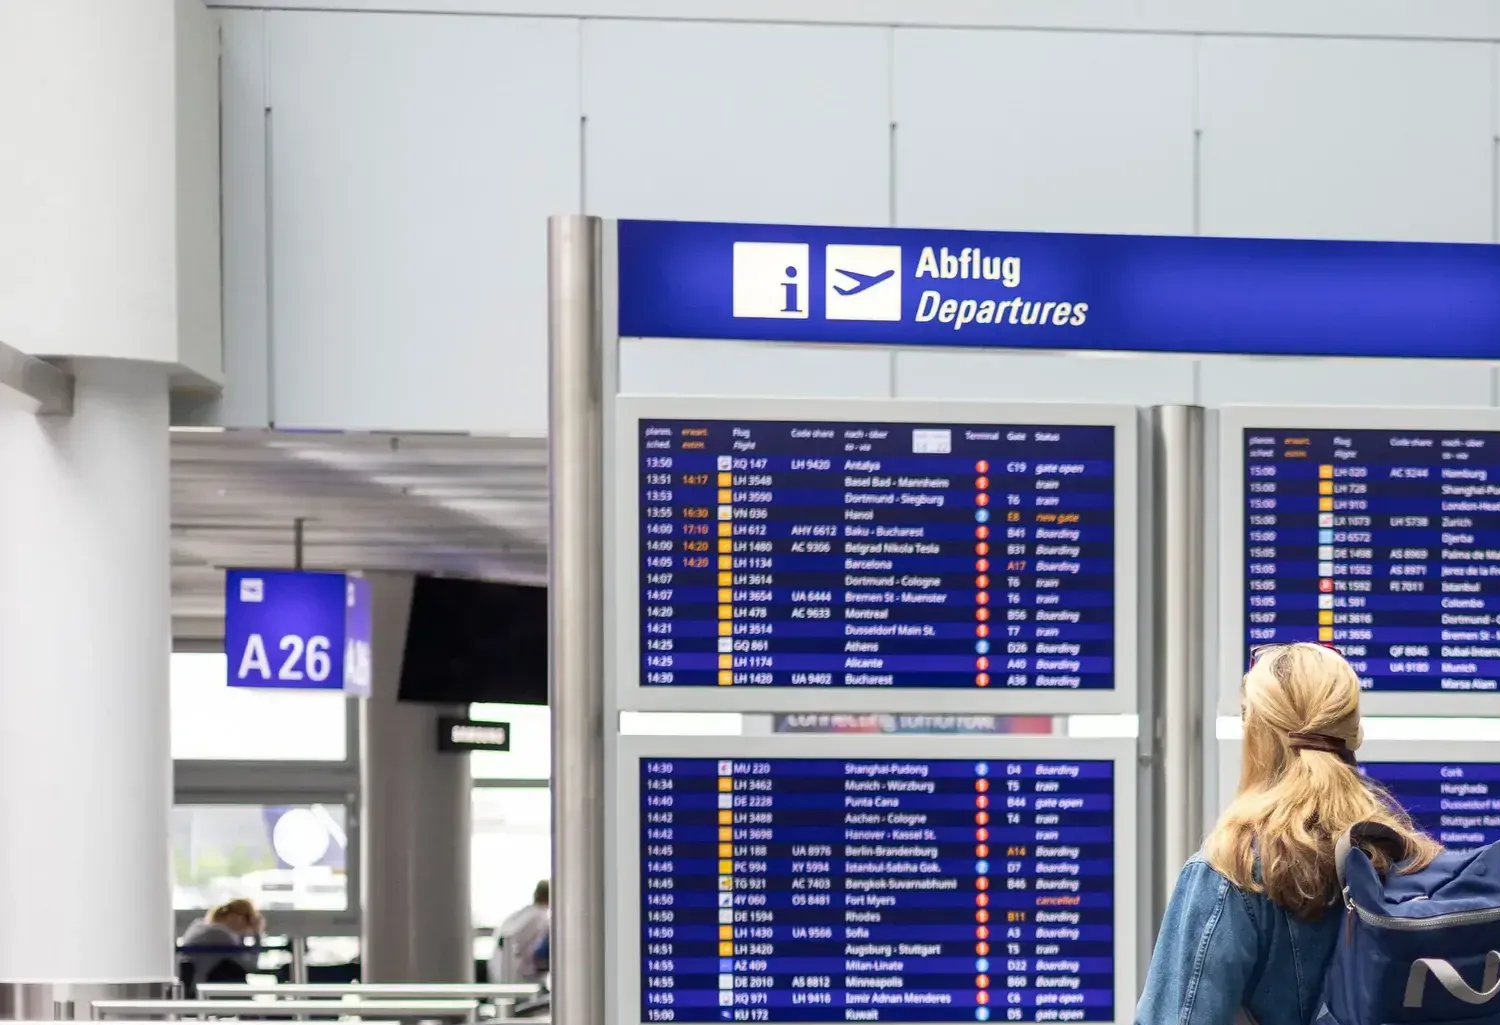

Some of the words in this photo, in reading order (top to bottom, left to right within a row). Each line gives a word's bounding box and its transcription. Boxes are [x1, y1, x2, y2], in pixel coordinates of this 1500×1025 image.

[915, 247, 1020, 287] Abflug
[915, 290, 1088, 330] Departures
[647, 457, 672, 468] 13:50
[750, 458, 767, 468] 147
[791, 460, 805, 469] LH
[806, 459, 830, 470] 9420
[844, 460, 880, 472] Antalya
[1007, 462, 1026, 472] C19
[1035, 464, 1057, 475] gate
[1058, 464, 1084, 475] open
[647, 474, 671, 484] 13:51
[683, 475, 708, 484] 14:17
[733, 475, 746, 485] LH
[845, 477, 870, 487] Basel
[872, 477, 891, 487] Bad
[898, 477, 949, 488] Mannheim
[1036, 480, 1059, 489] train
[647, 507, 672, 517] 13:55
[683, 508, 708, 518] 16:30
[845, 510, 873, 520] Hanoi
[1036, 514, 1056, 522] new
[1057, 514, 1079, 524] gate
[683, 557, 709, 567] 14:20
[733, 558, 747, 568] LH
[749, 558, 772, 568] 1134
[845, 559, 892, 569] Barcelona
[1007, 561, 1026, 570] A17
[1036, 561, 1080, 573] Boarding
[1442, 583, 1480, 592] Istanbul
[648, 607, 673, 617] 14:20
[734, 608, 747, 617] LH
[792, 608, 805, 618] AC
[845, 608, 888, 619] Montreal
[1036, 610, 1080, 623] Boarding
[647, 623, 671, 633] 14:21
[734, 624, 747, 634] LH
[749, 623, 772, 634] 3514
[845, 624, 897, 635] Dusseldorf
[898, 625, 921, 635] Main
[1008, 626, 1020, 636] T7
[1036, 628, 1059, 636] train
[648, 639, 673, 650] 14:25
[845, 641, 878, 652] Athens
[1036, 643, 1080, 655] Boarding
[648, 656, 673, 666] 14:25
[734, 657, 747, 667] LH
[750, 656, 772, 667] 1174
[845, 658, 883, 668] Alicante
[1036, 659, 1080, 672] Boarding
[1442, 663, 1477, 672] Munich
[648, 672, 673, 683] 14:30
[734, 674, 747, 684] LH
[792, 674, 806, 684] UA
[845, 674, 893, 685] Bucharest
[1035, 676, 1081, 689] Boarding
[648, 763, 673, 773] 14:30
[845, 763, 928, 777] Shanghai-Pudong
[1007, 764, 1021, 774] D4
[1036, 764, 1079, 777] Boarding
[1441, 767, 1463, 777] Cork
[1441, 784, 1488, 796] Hurghada
[1441, 816, 1482, 828] Stuttgart
[846, 862, 918, 872] Istanbul-Sabiha
[1007, 862, 1021, 873] D7
[1036, 862, 1079, 875] Boarding
[649, 1009, 674, 1020] 15:00
[752, 1009, 768, 1020] 172
[846, 1009, 878, 1020] Kuwait
[1035, 1009, 1058, 1022] gate
[1058, 1009, 1085, 1022] open
